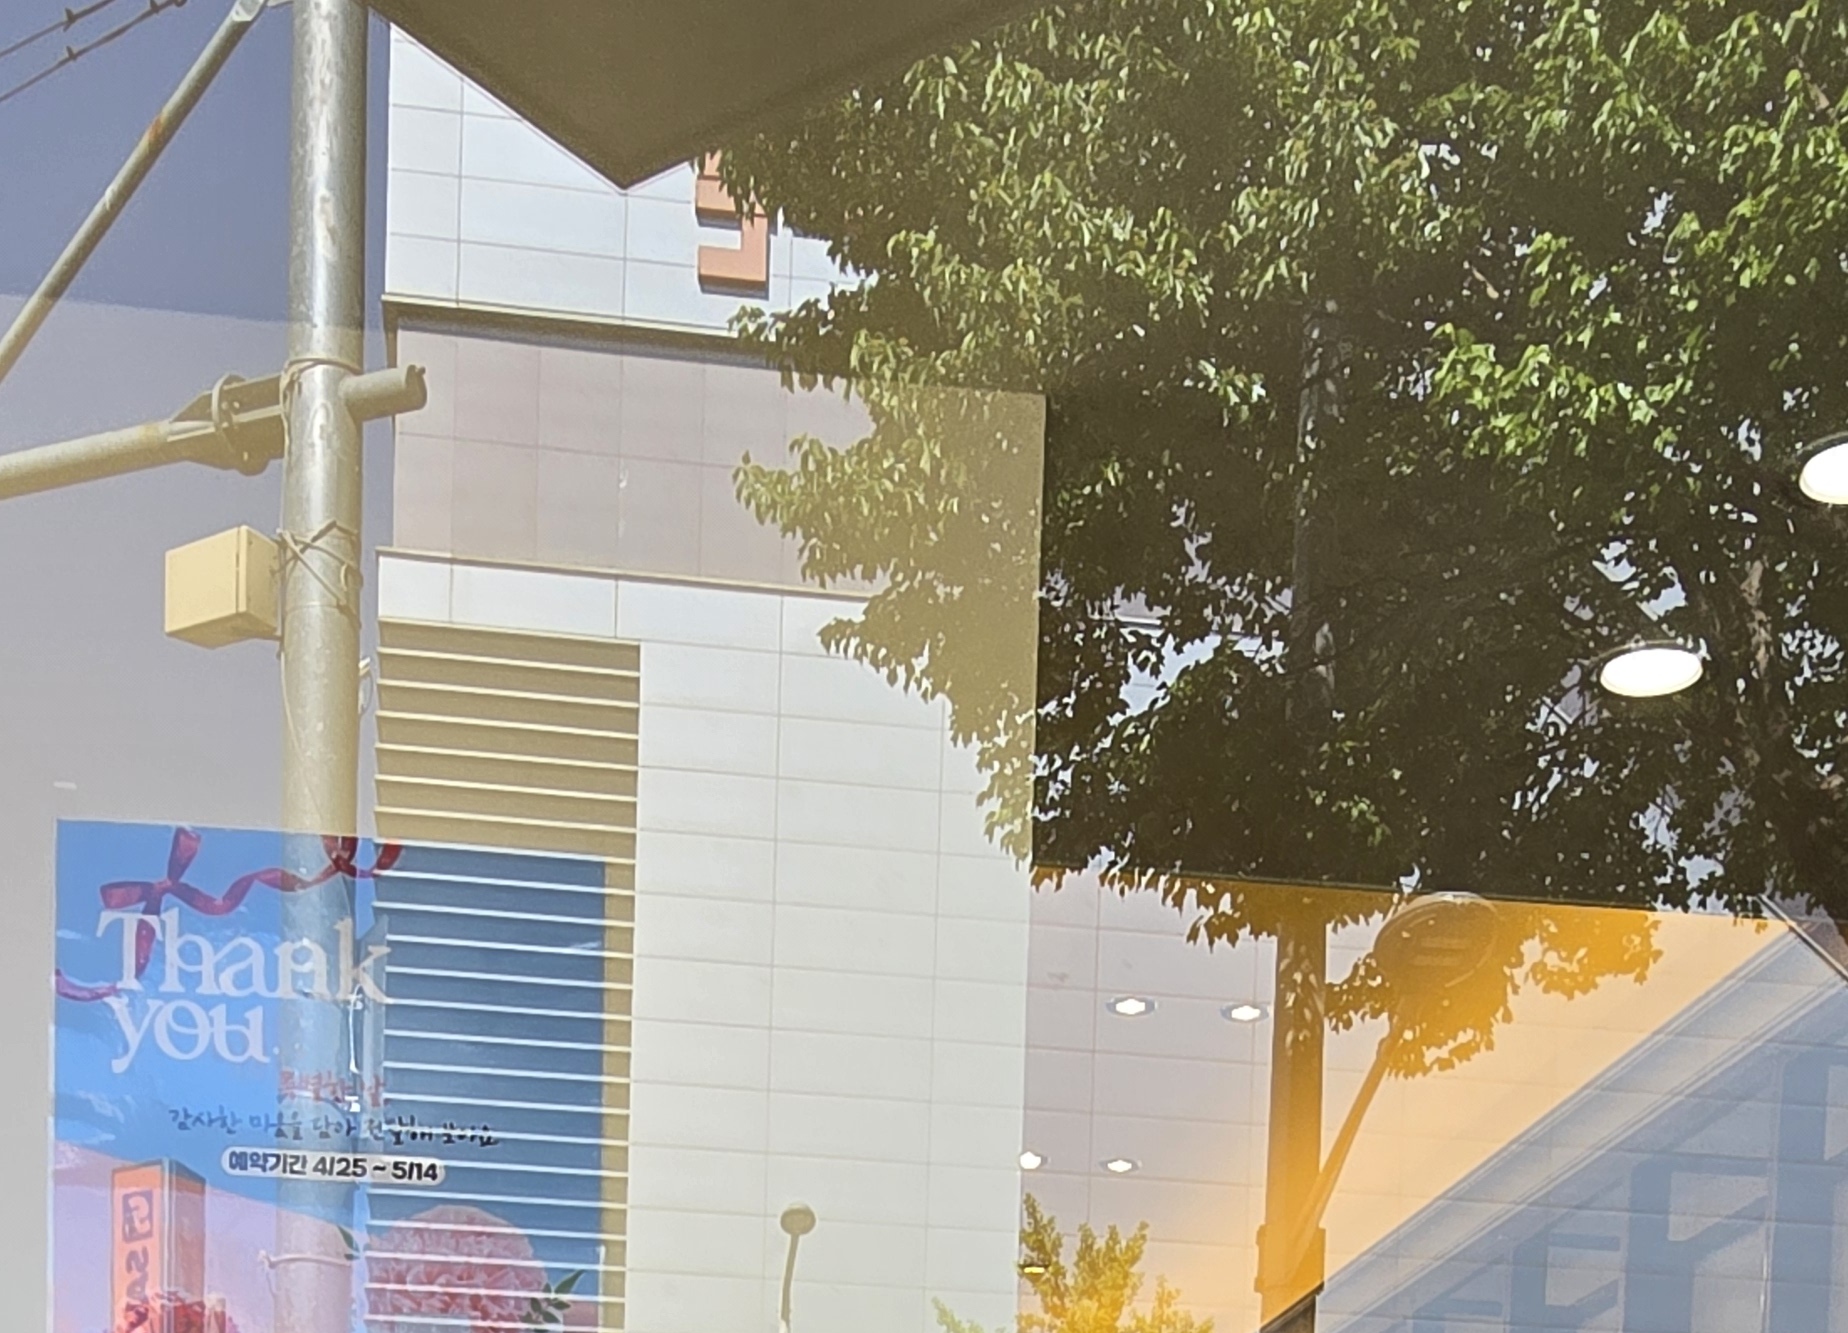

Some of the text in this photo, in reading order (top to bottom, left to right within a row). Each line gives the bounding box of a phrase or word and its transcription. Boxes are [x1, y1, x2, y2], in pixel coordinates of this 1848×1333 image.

[97, 906, 393, 1005] Thank
[168, 1104, 242, 1135] 감사한
[248, 1110, 303, 1141] 마음을
[311, 1114, 357, 1139] 담아
[228, 1149, 307, 1176] 예약기간
[313, 1156, 368, 1178] 4/25
[391, 1160, 439, 1182] 5/14
